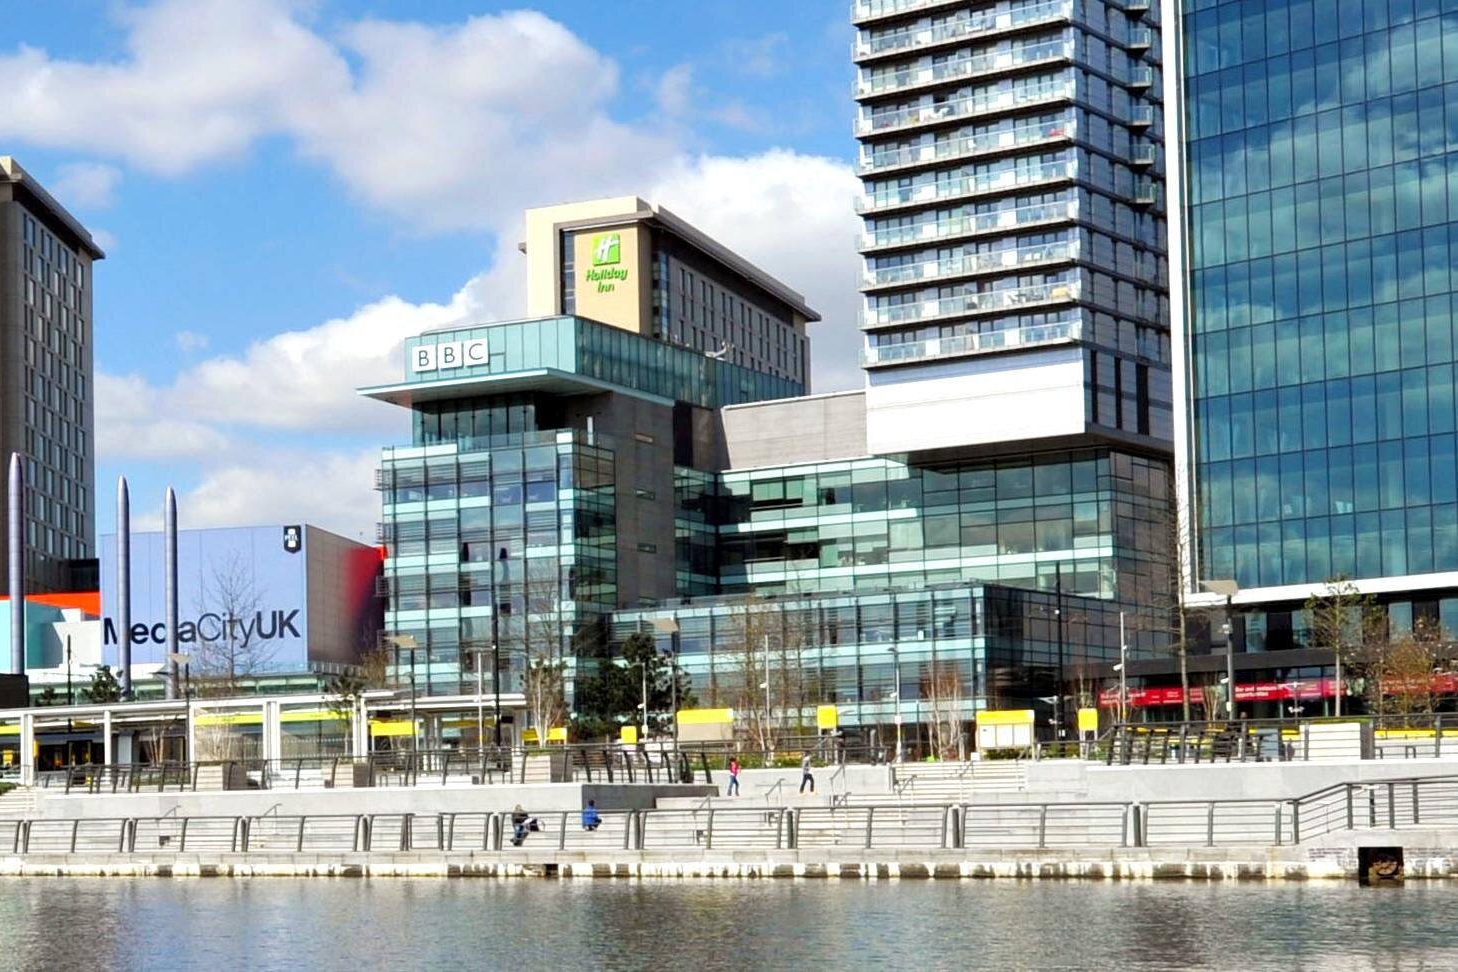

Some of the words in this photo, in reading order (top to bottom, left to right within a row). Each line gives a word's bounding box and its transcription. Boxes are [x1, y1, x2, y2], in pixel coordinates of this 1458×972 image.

[585, 268, 629, 282] Holiday
[597, 281, 616, 294] Inn
[418, 343, 484, 367] BBC
[103, 609, 301, 649] MedaCityUK
